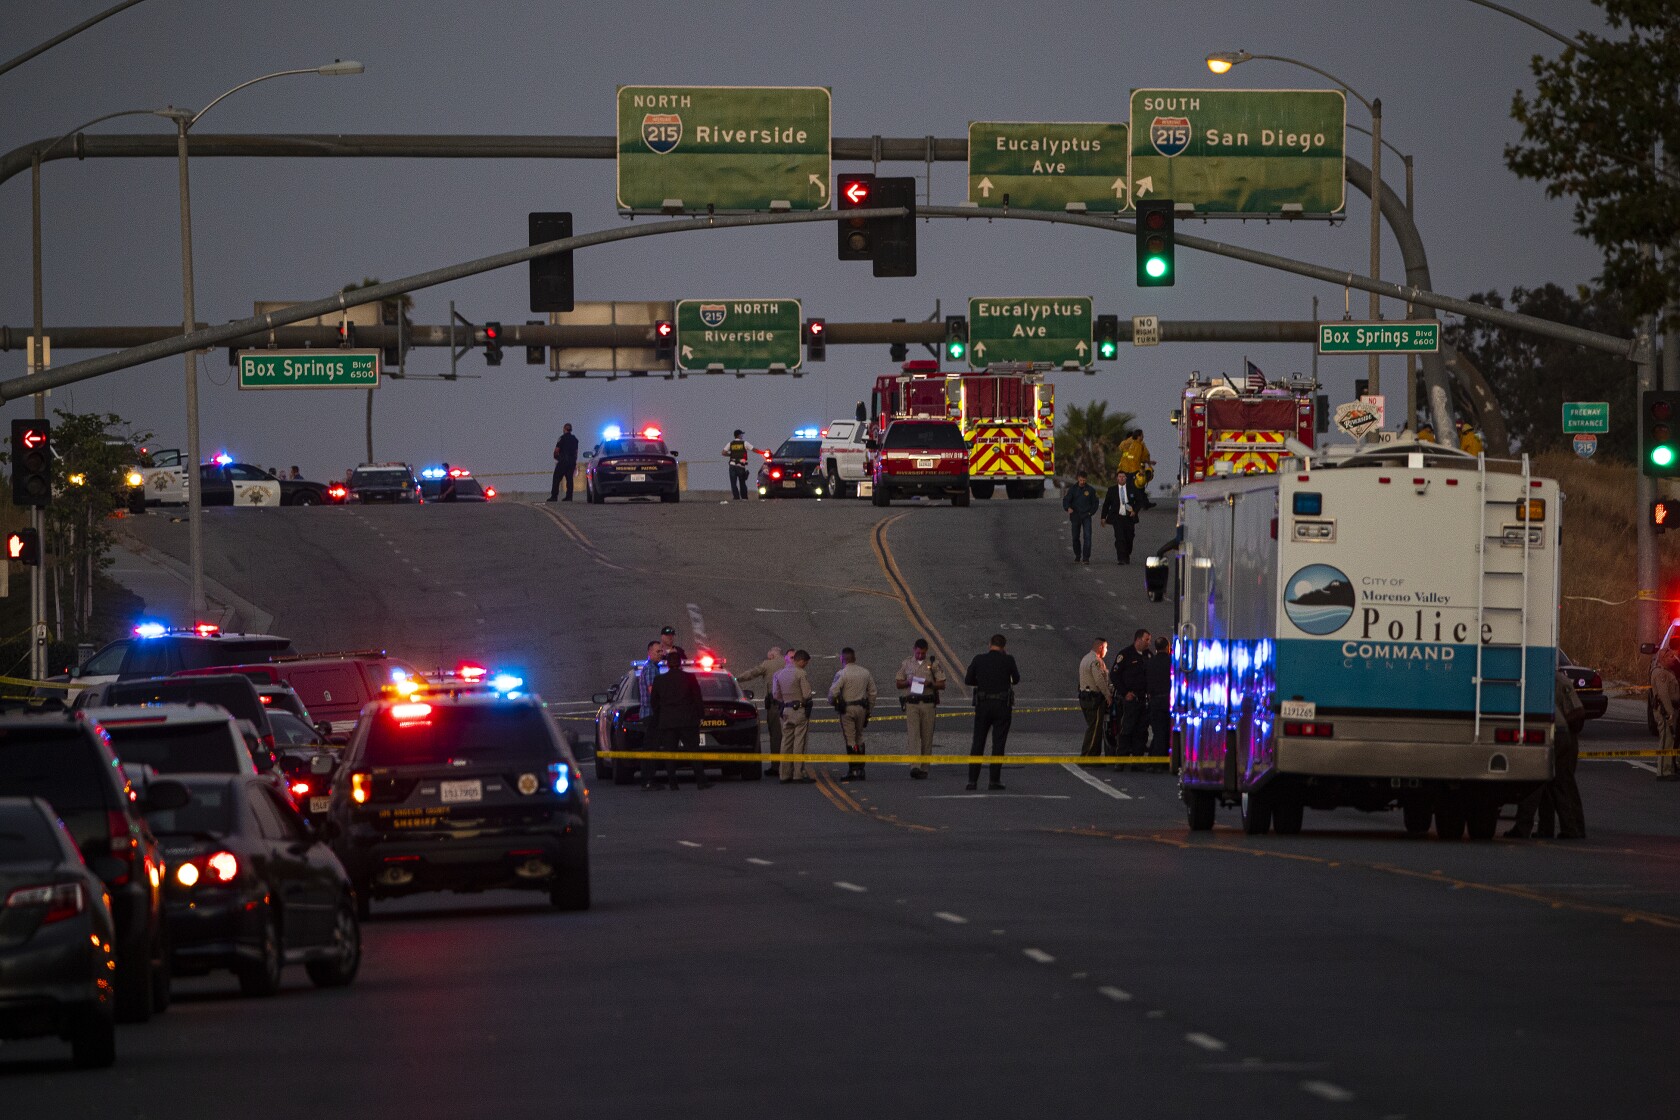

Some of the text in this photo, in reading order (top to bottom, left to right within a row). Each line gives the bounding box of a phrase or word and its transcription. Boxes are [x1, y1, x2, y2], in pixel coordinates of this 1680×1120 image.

[634, 95, 691, 108] NORTH
[1144, 98, 1200, 111] SOUTH
[648, 126, 678, 141] 215
[696, 126, 807, 144] Riverside
[1156, 129, 1187, 145] 215
[996, 136, 1101, 154] Eucalyptus
[1206, 129, 1325, 152] San Diego
[1032, 160, 1066, 174] Ave
[734, 303, 778, 314] NORTH
[978, 303, 1082, 319] Eucalyptus
[705, 312, 723, 321] 215
[1139, 318, 1152, 327] NO
[705, 330, 774, 341] Riverside
[1013, 323, 1047, 337] Ave
[1323, 329, 1349, 343] Box
[1356, 329, 1409, 346] Springs
[245, 360, 372, 381] Box Springs Blvd
[350, 370, 374, 378] 6500
[1368, 397, 1377, 405] NO
[1570, 408, 1601, 416] FREEWAY
[1568, 419, 1603, 427] ENTRANCE
[1379, 434, 1391, 443] NO
[1577, 443, 1593, 453] 215
[1362, 577, 1405, 587] CITY OF
[1362, 590, 1451, 604] Moreno Valley
[1361, 607, 1493, 644] Police
[1342, 641, 1455, 660] COMMAND
[1343, 660, 1452, 671] CENTER
